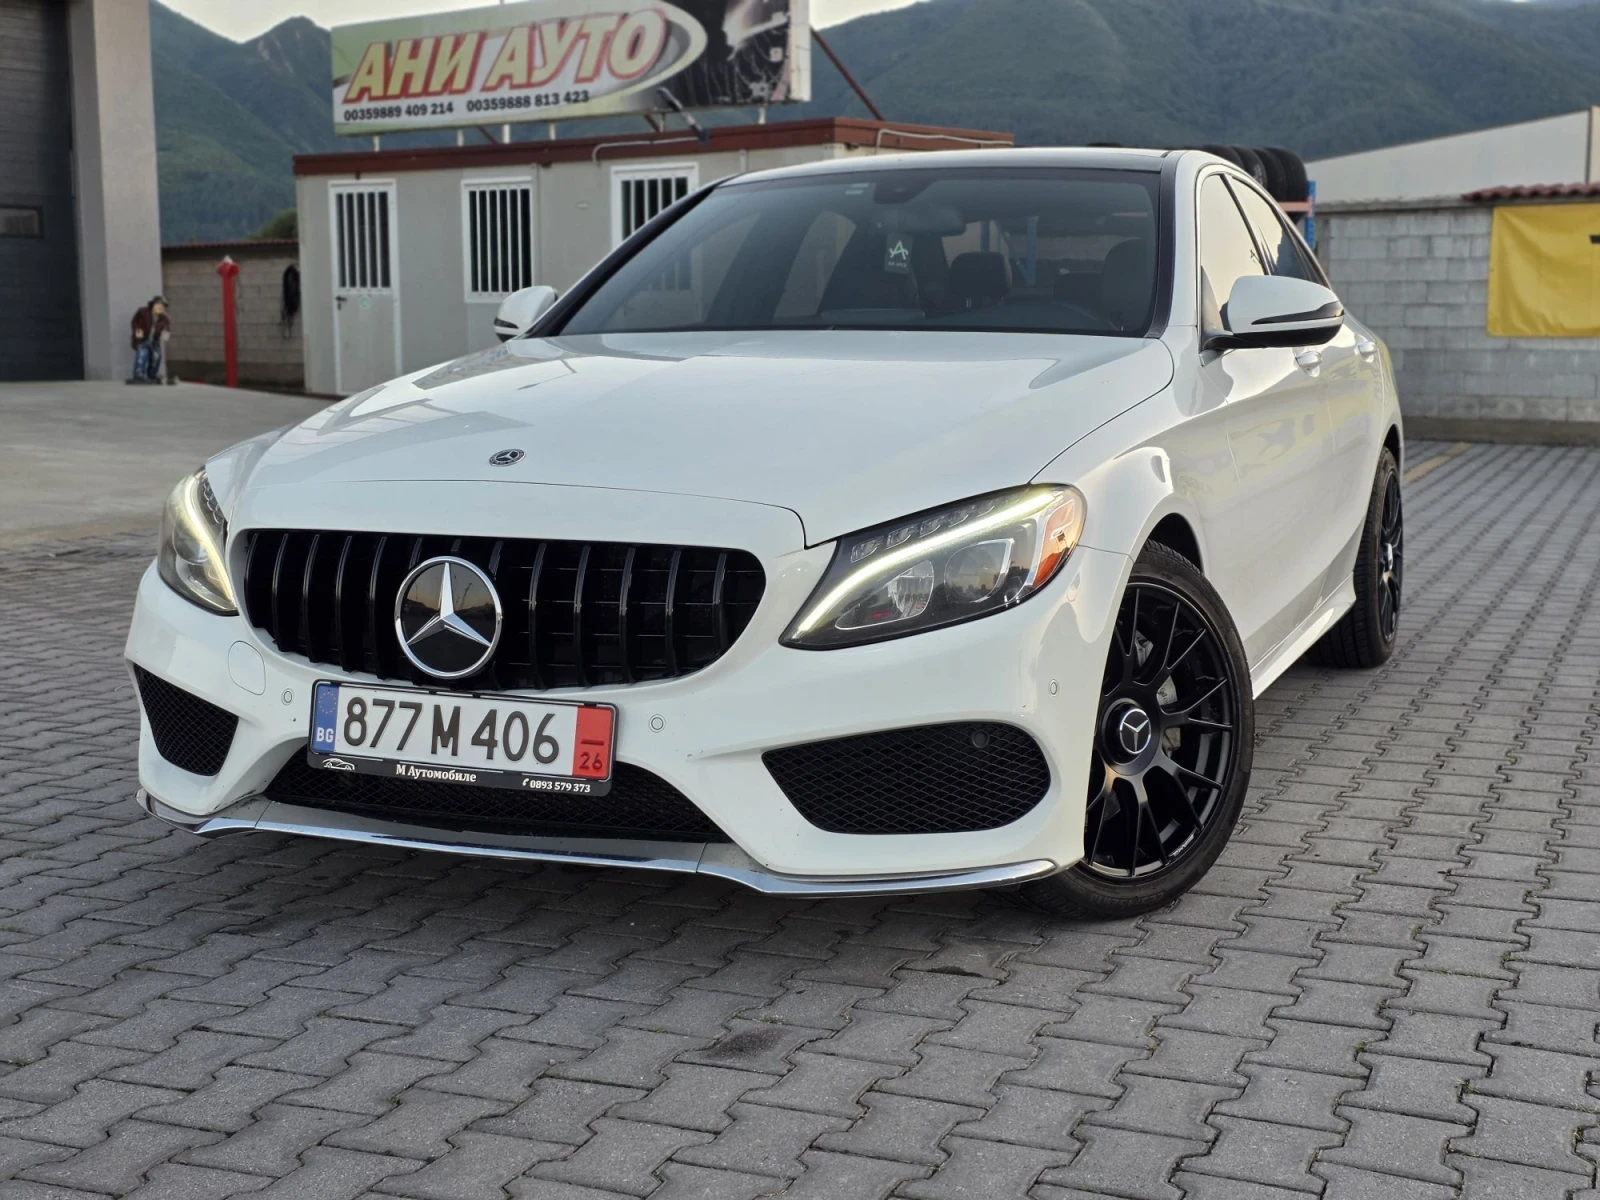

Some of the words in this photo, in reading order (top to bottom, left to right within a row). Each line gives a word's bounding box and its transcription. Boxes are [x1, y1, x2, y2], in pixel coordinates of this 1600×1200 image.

[342, 31, 487, 104] АНИ
[480, 8, 668, 92] АУТО
[344, 105, 402, 122] 00359889
[405, 103, 428, 117] 409
[430, 101, 454, 115] 214
[466, 95, 531, 112] 00359888
[534, 92, 560, 107] 813
[563, 90, 590, 105] 423
[316, 727, 335, 743] BG
[343, 695, 424, 752] 877
[430, 704, 462, 757] M
[471, 708, 560, 765] 406
[579, 751, 603, 771] 26
[396, 764, 408, 776] М
[408, 766, 477, 783] Аутомобиле
[529, 780, 552, 791] 0893
[554, 781, 572, 792] 579
[573, 783, 591, 794] 373
